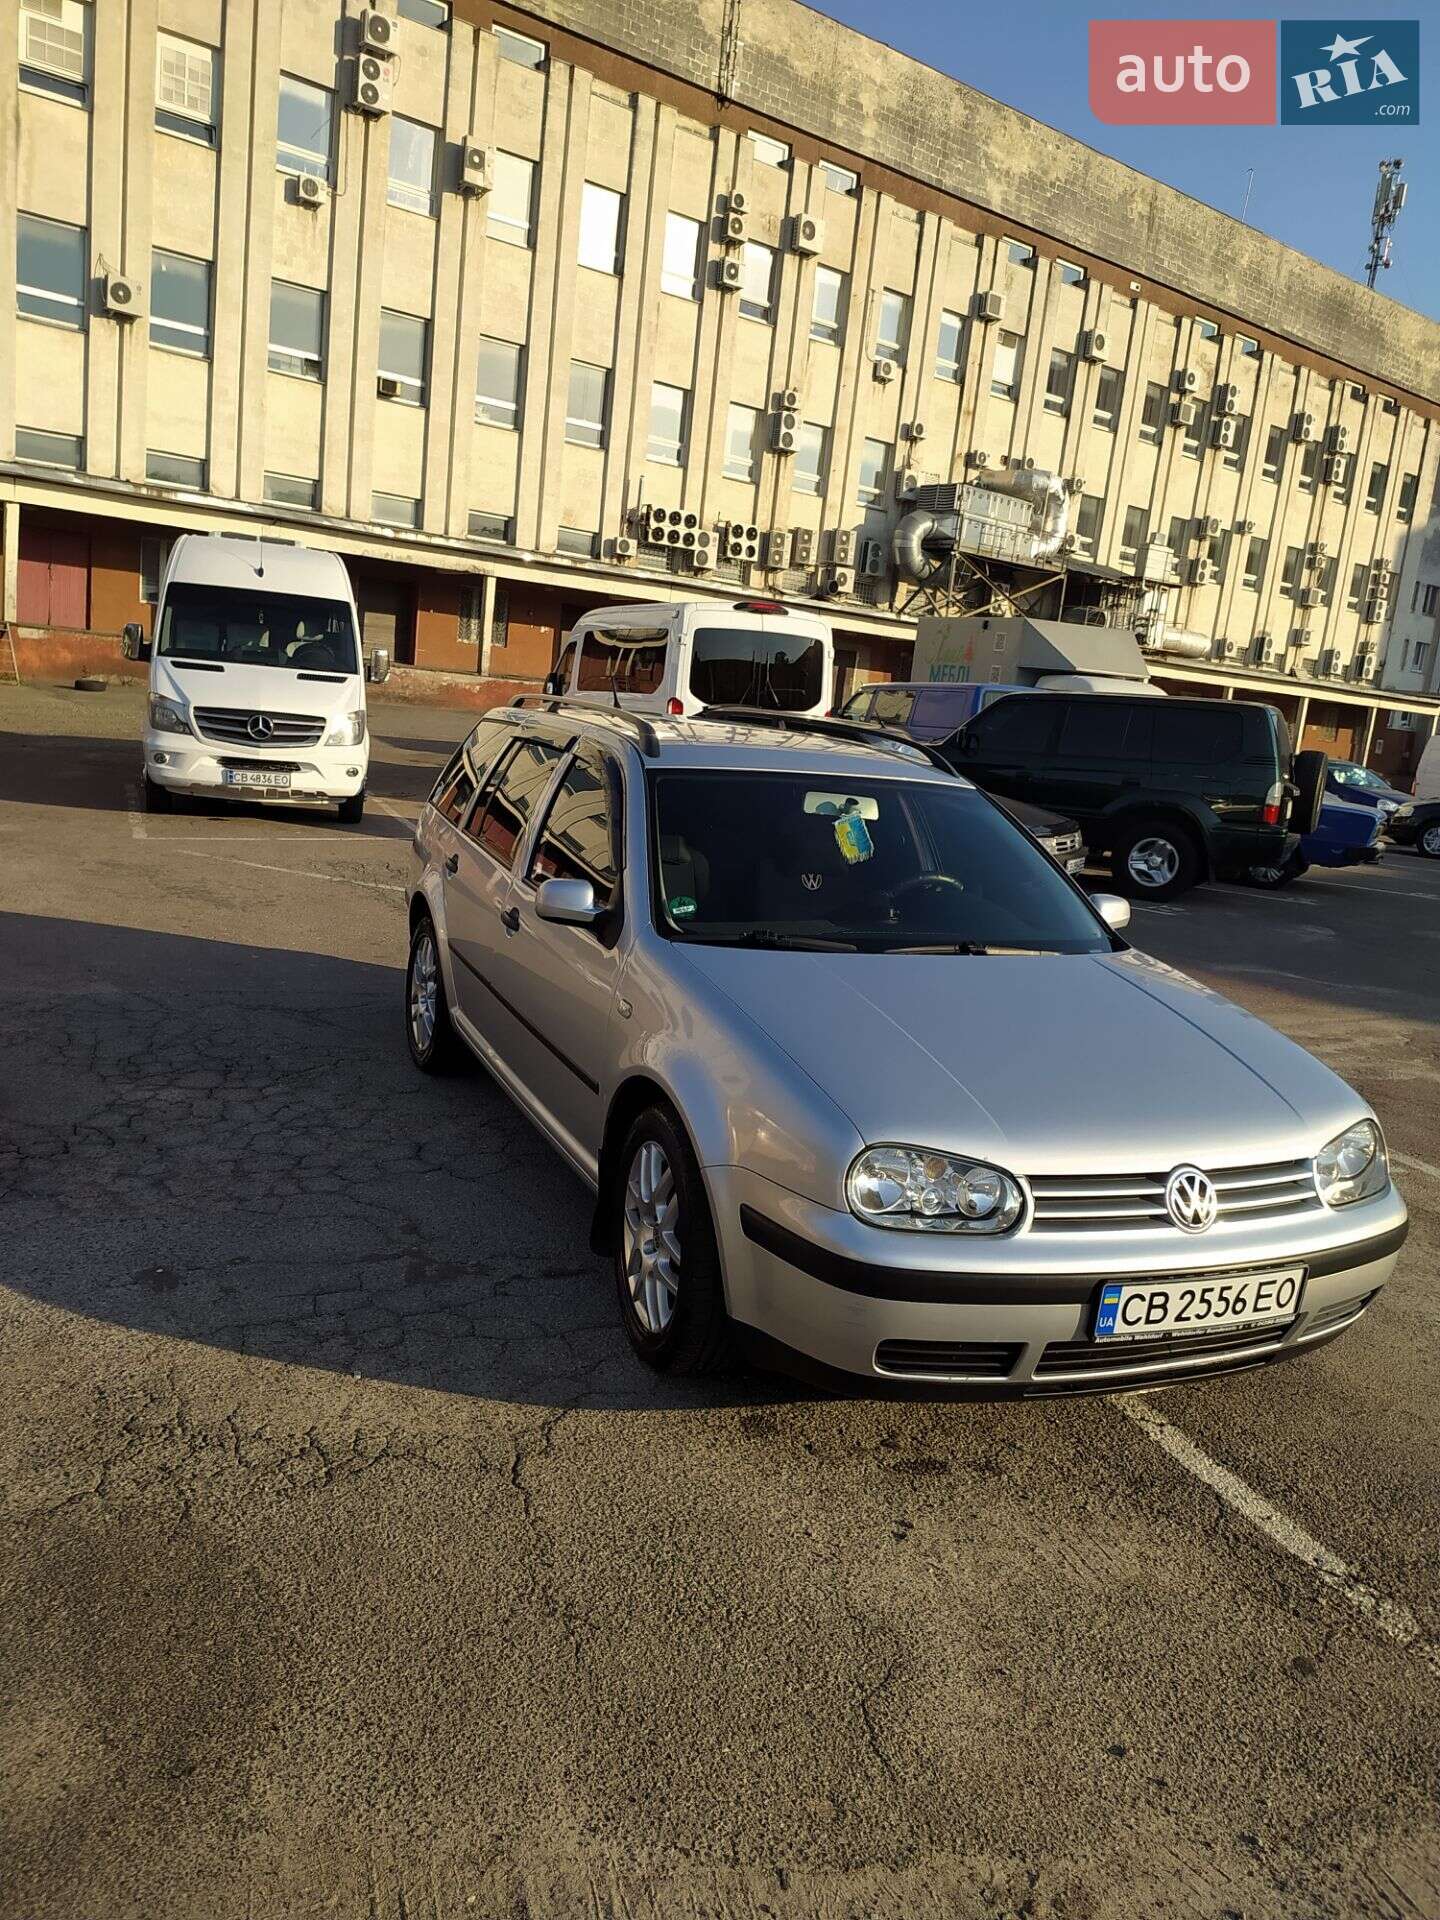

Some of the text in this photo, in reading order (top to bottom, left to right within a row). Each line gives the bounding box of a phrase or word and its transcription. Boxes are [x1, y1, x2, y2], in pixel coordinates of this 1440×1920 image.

[250, 774, 273, 784] 4836
[1121, 1277, 1296, 1326] CB 2556 EO
[1099, 1317, 1114, 1328] UA
